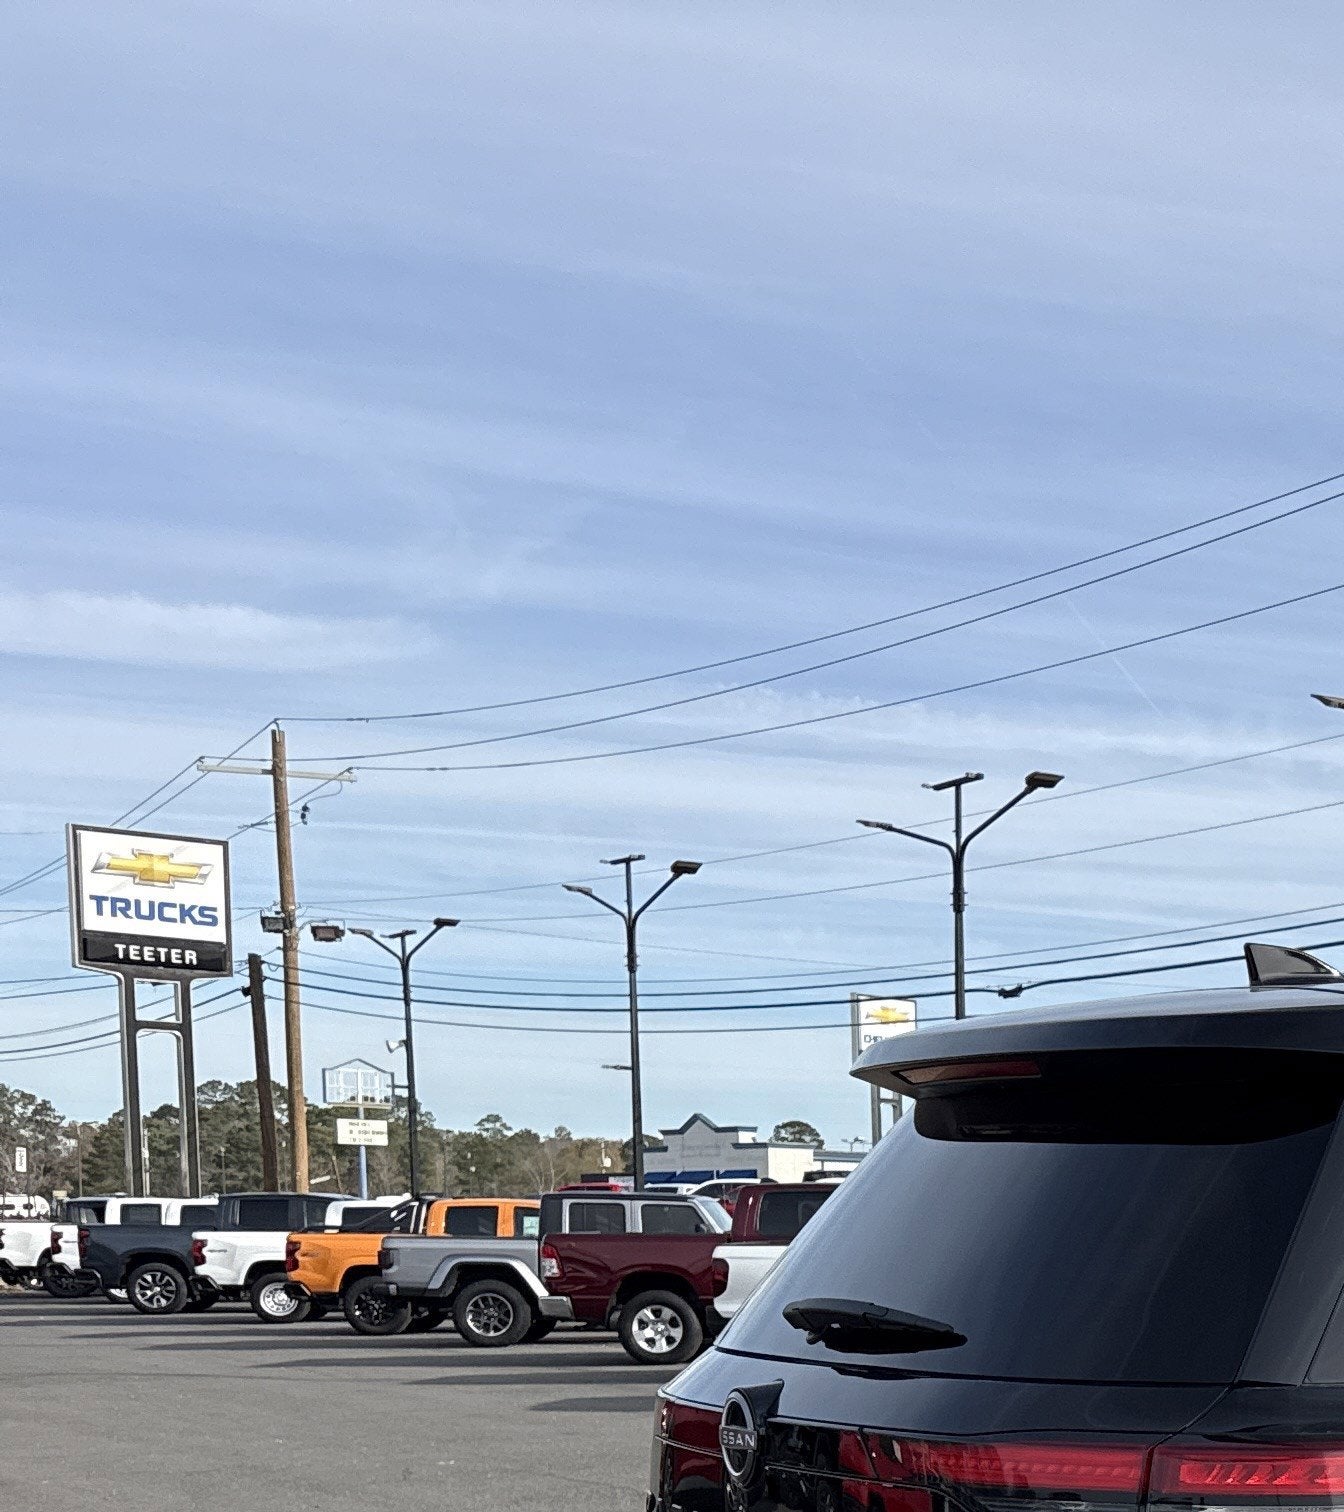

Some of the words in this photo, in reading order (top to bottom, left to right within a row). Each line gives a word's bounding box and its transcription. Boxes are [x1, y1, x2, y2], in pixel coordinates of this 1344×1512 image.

[89, 894, 219, 927] TRUCKS
[114, 943, 198, 966] TEETER
[722, 1430, 755, 1447] SSAN
